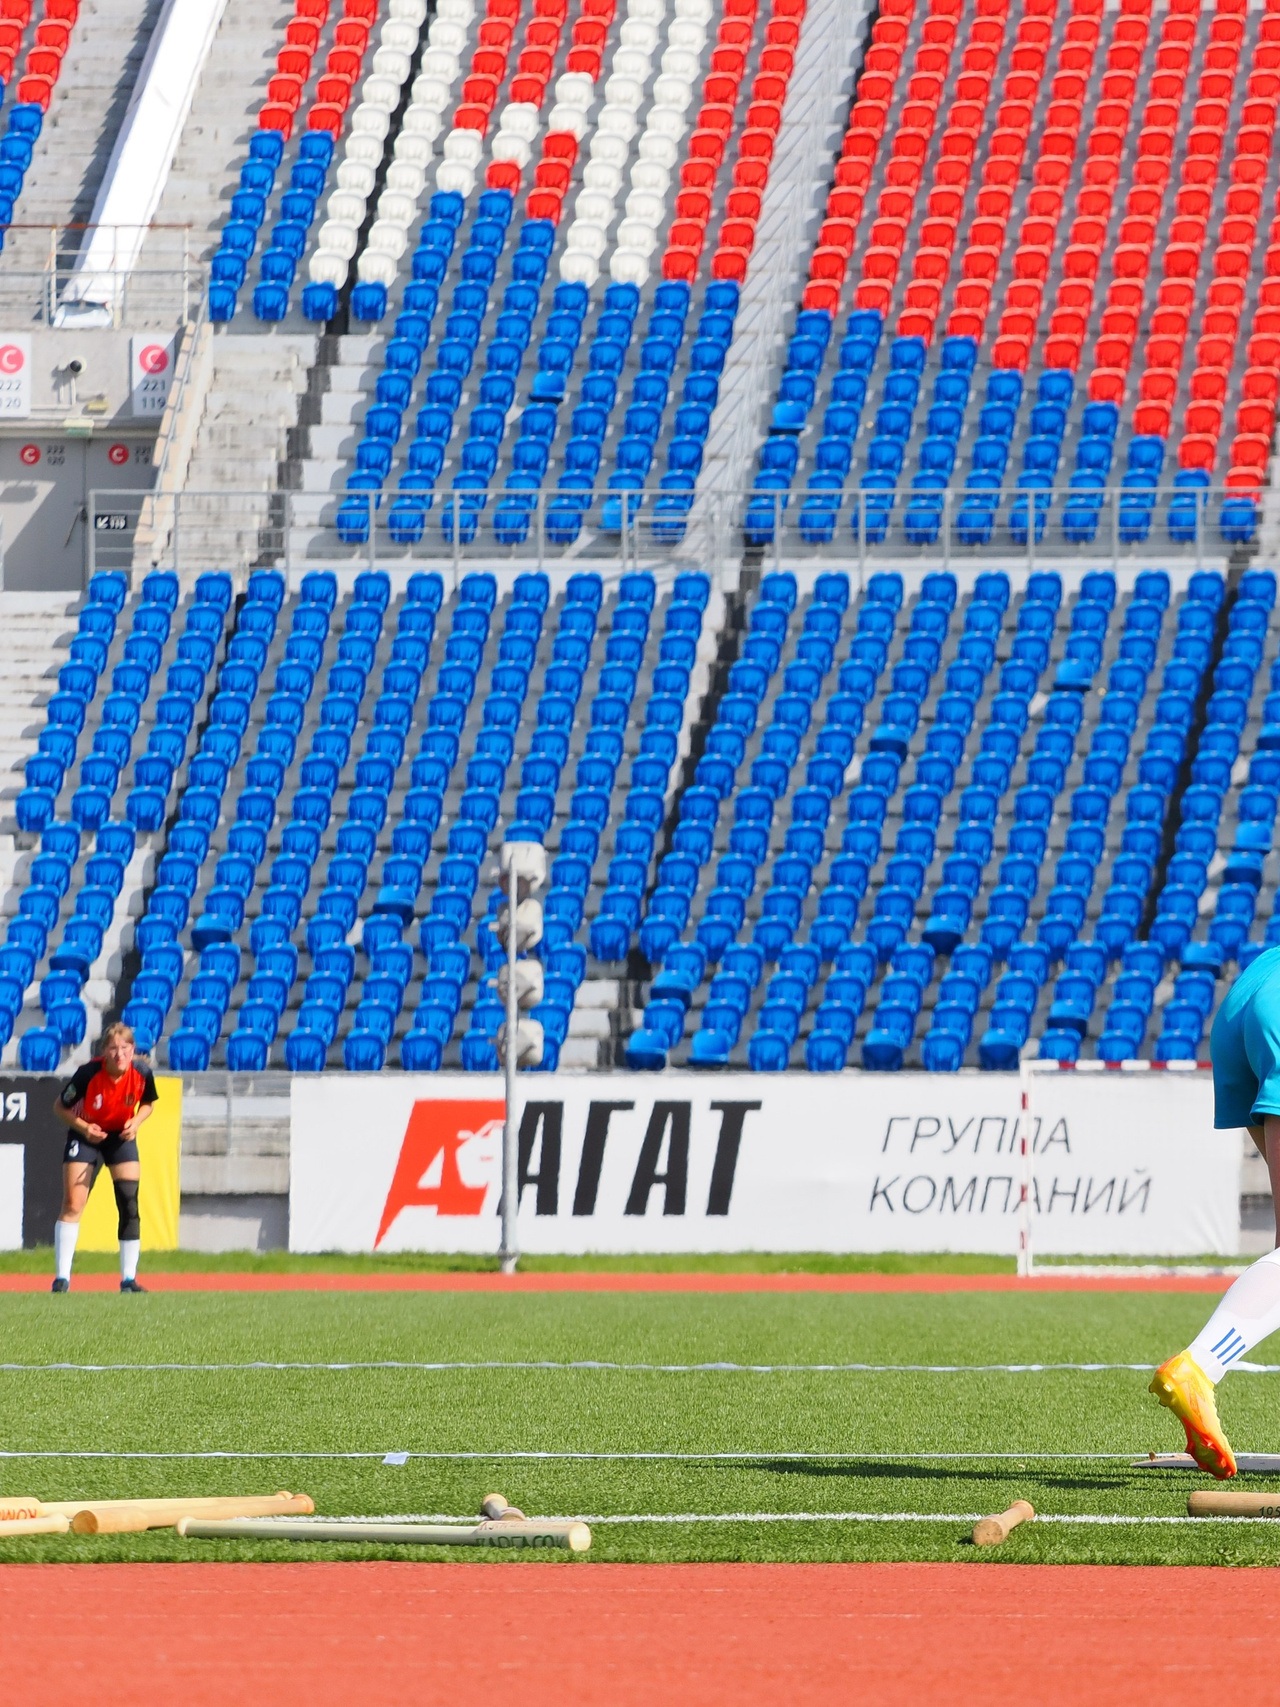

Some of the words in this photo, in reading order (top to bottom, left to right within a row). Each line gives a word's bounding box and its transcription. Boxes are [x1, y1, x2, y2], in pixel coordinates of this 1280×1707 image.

[143, 379, 166, 391] 221
[142, 397, 166, 409] 119
[881, 1115, 1072, 1154] ГРУППА
